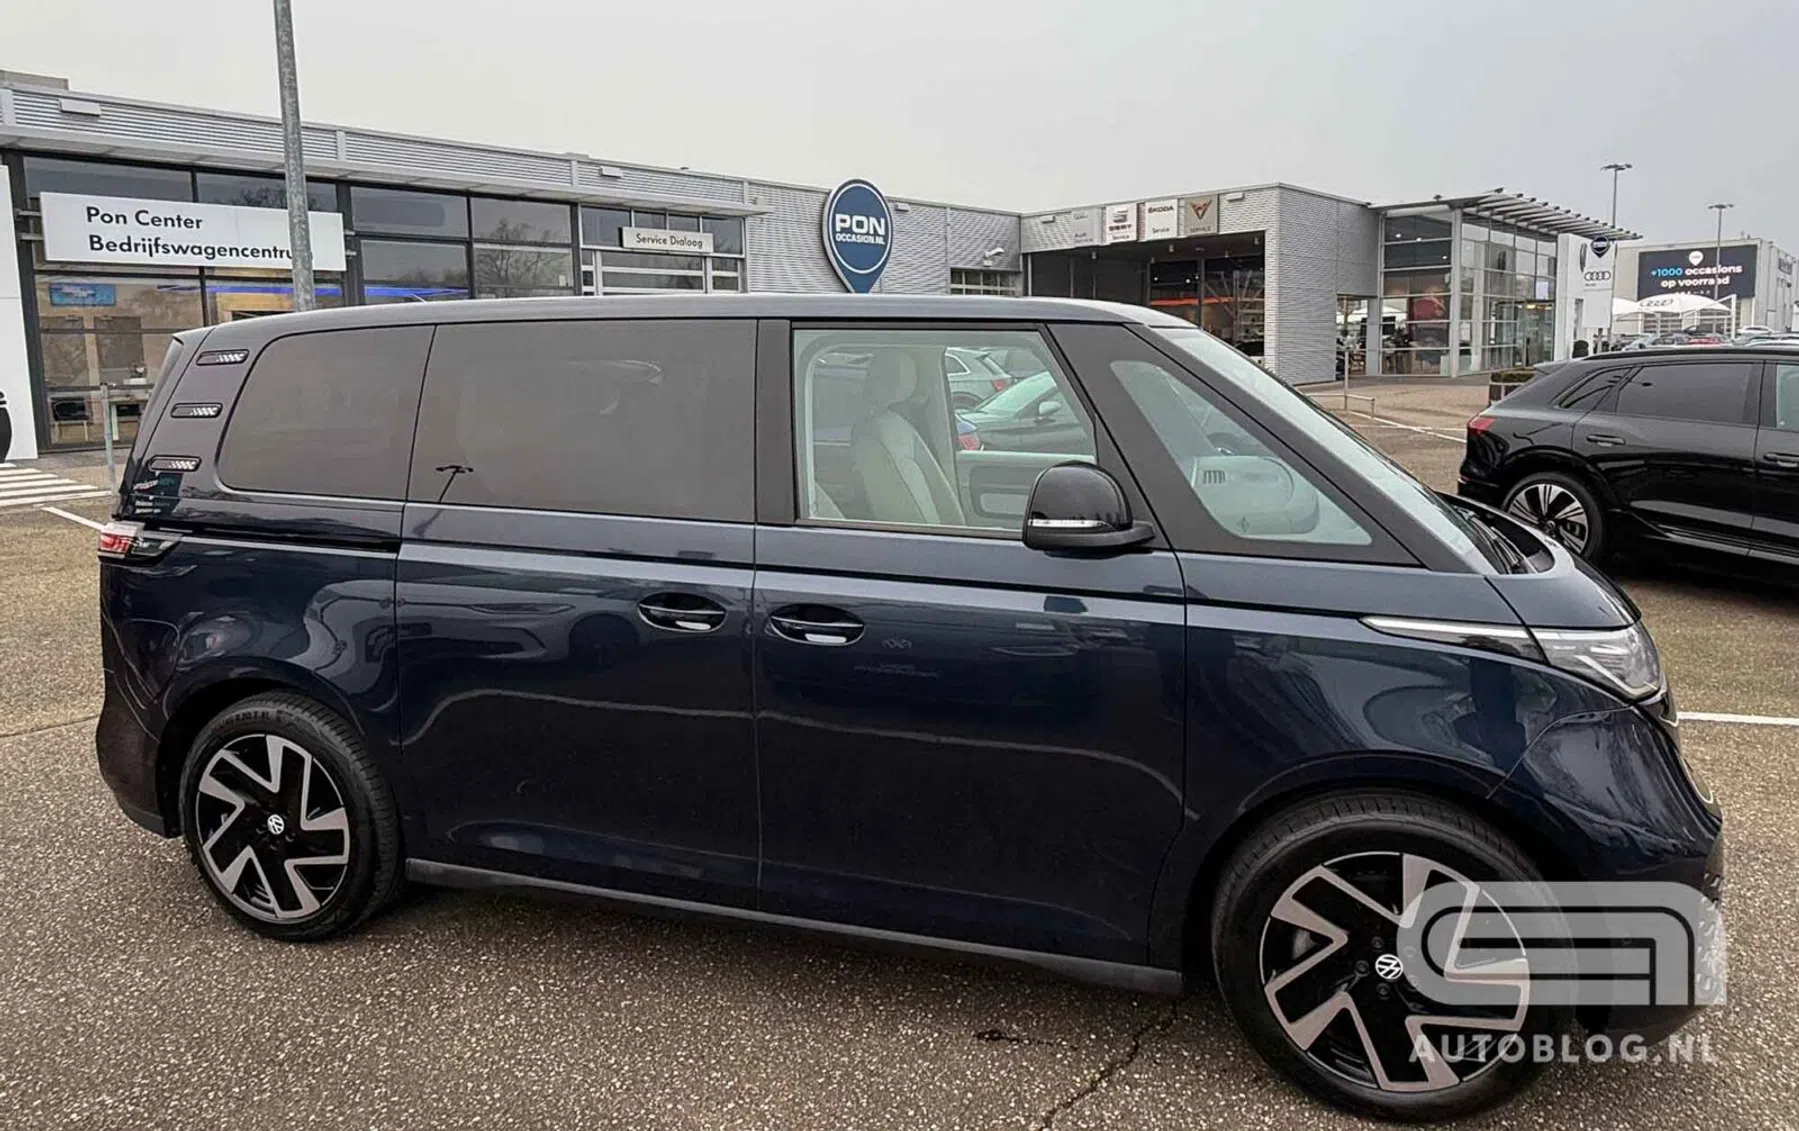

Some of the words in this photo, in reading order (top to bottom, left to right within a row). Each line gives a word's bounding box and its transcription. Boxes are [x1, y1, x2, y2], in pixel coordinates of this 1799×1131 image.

[86, 206, 127, 225] Pon
[135, 209, 203, 230] Center
[835, 213, 885, 235] PON
[88, 234, 312, 261] Bedrijfswagencentru
[635, 232, 667, 245] Service
[669, 235, 703, 249] Dialoog
[835, 232, 886, 246] OCCASION.NL
[1684, 264, 1743, 276] occasions
[1660, 279, 1676, 289] op
